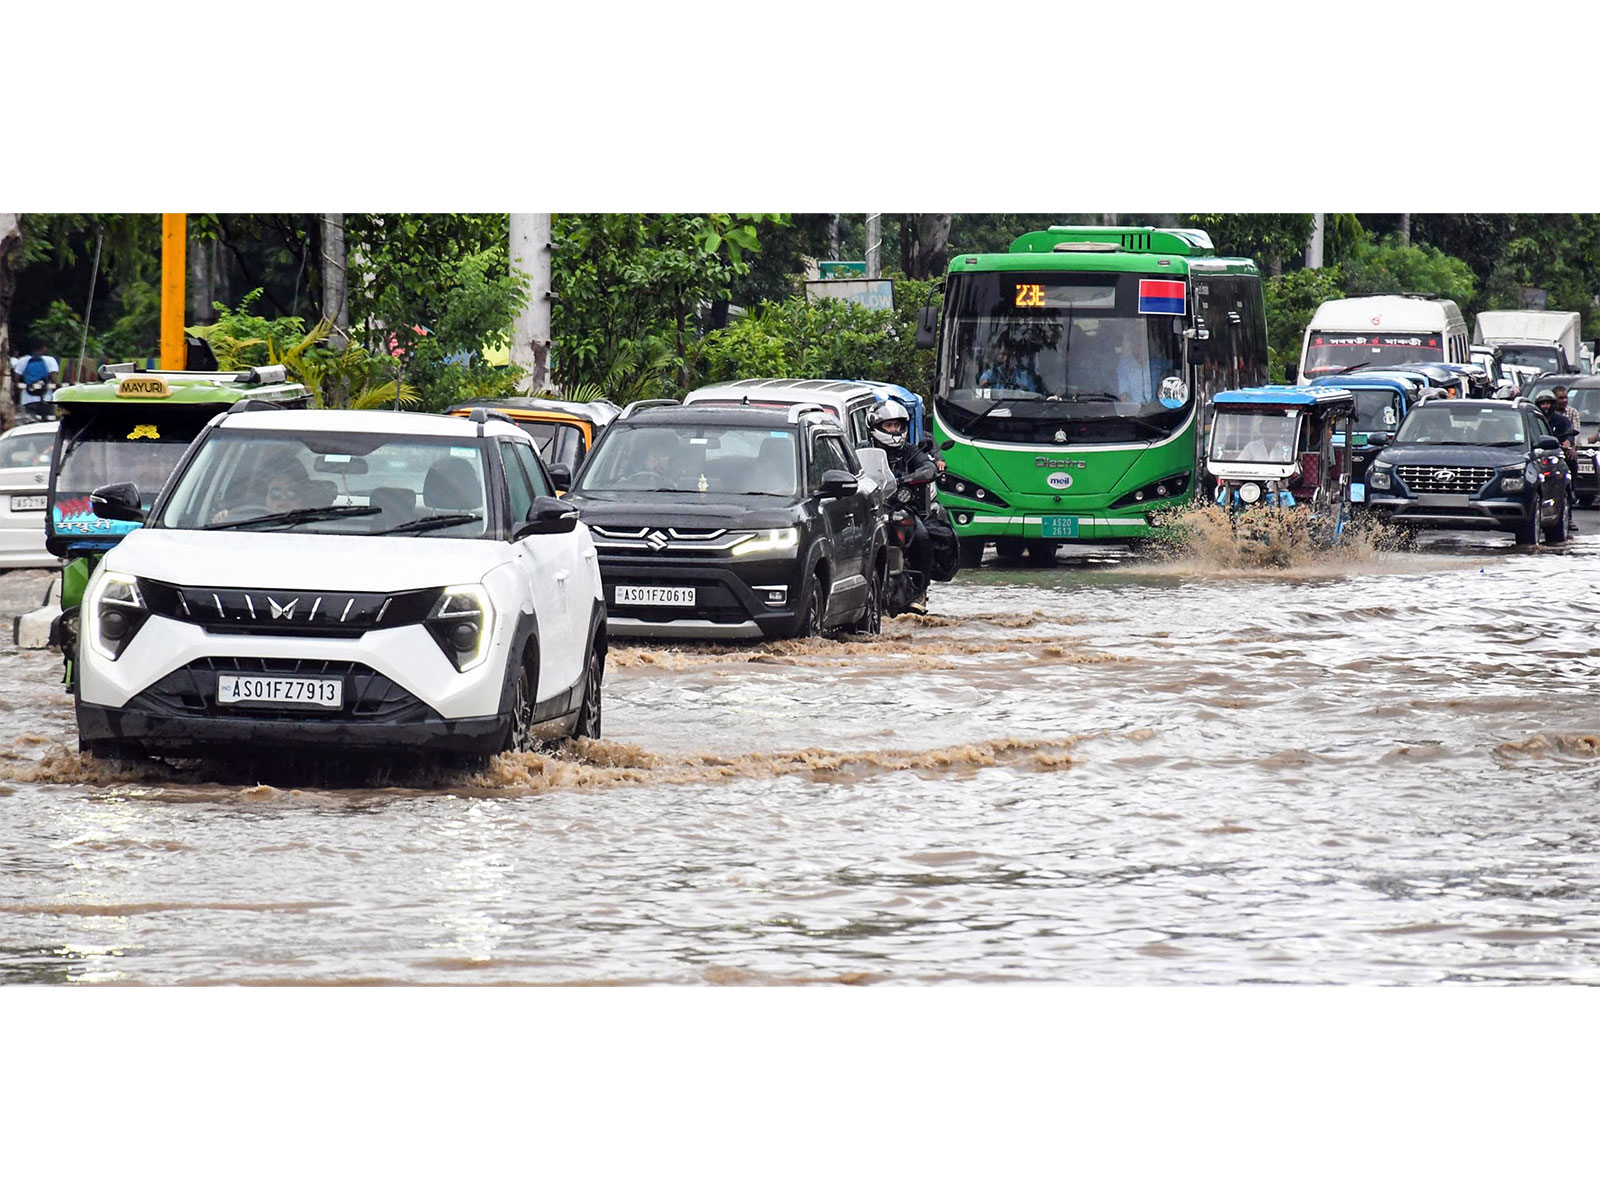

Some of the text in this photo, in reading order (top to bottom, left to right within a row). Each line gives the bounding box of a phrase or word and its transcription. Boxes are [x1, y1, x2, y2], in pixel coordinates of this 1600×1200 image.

[1016, 284, 1045, 305] 23E
[121, 382, 163, 393] MAYURI
[1050, 477, 1070, 485] meil
[1052, 518, 1072, 527] AS20
[1052, 527, 1072, 536] 2613
[624, 589, 694, 602] AS01FZ0619
[233, 680, 335, 701] AS01FZ7913
